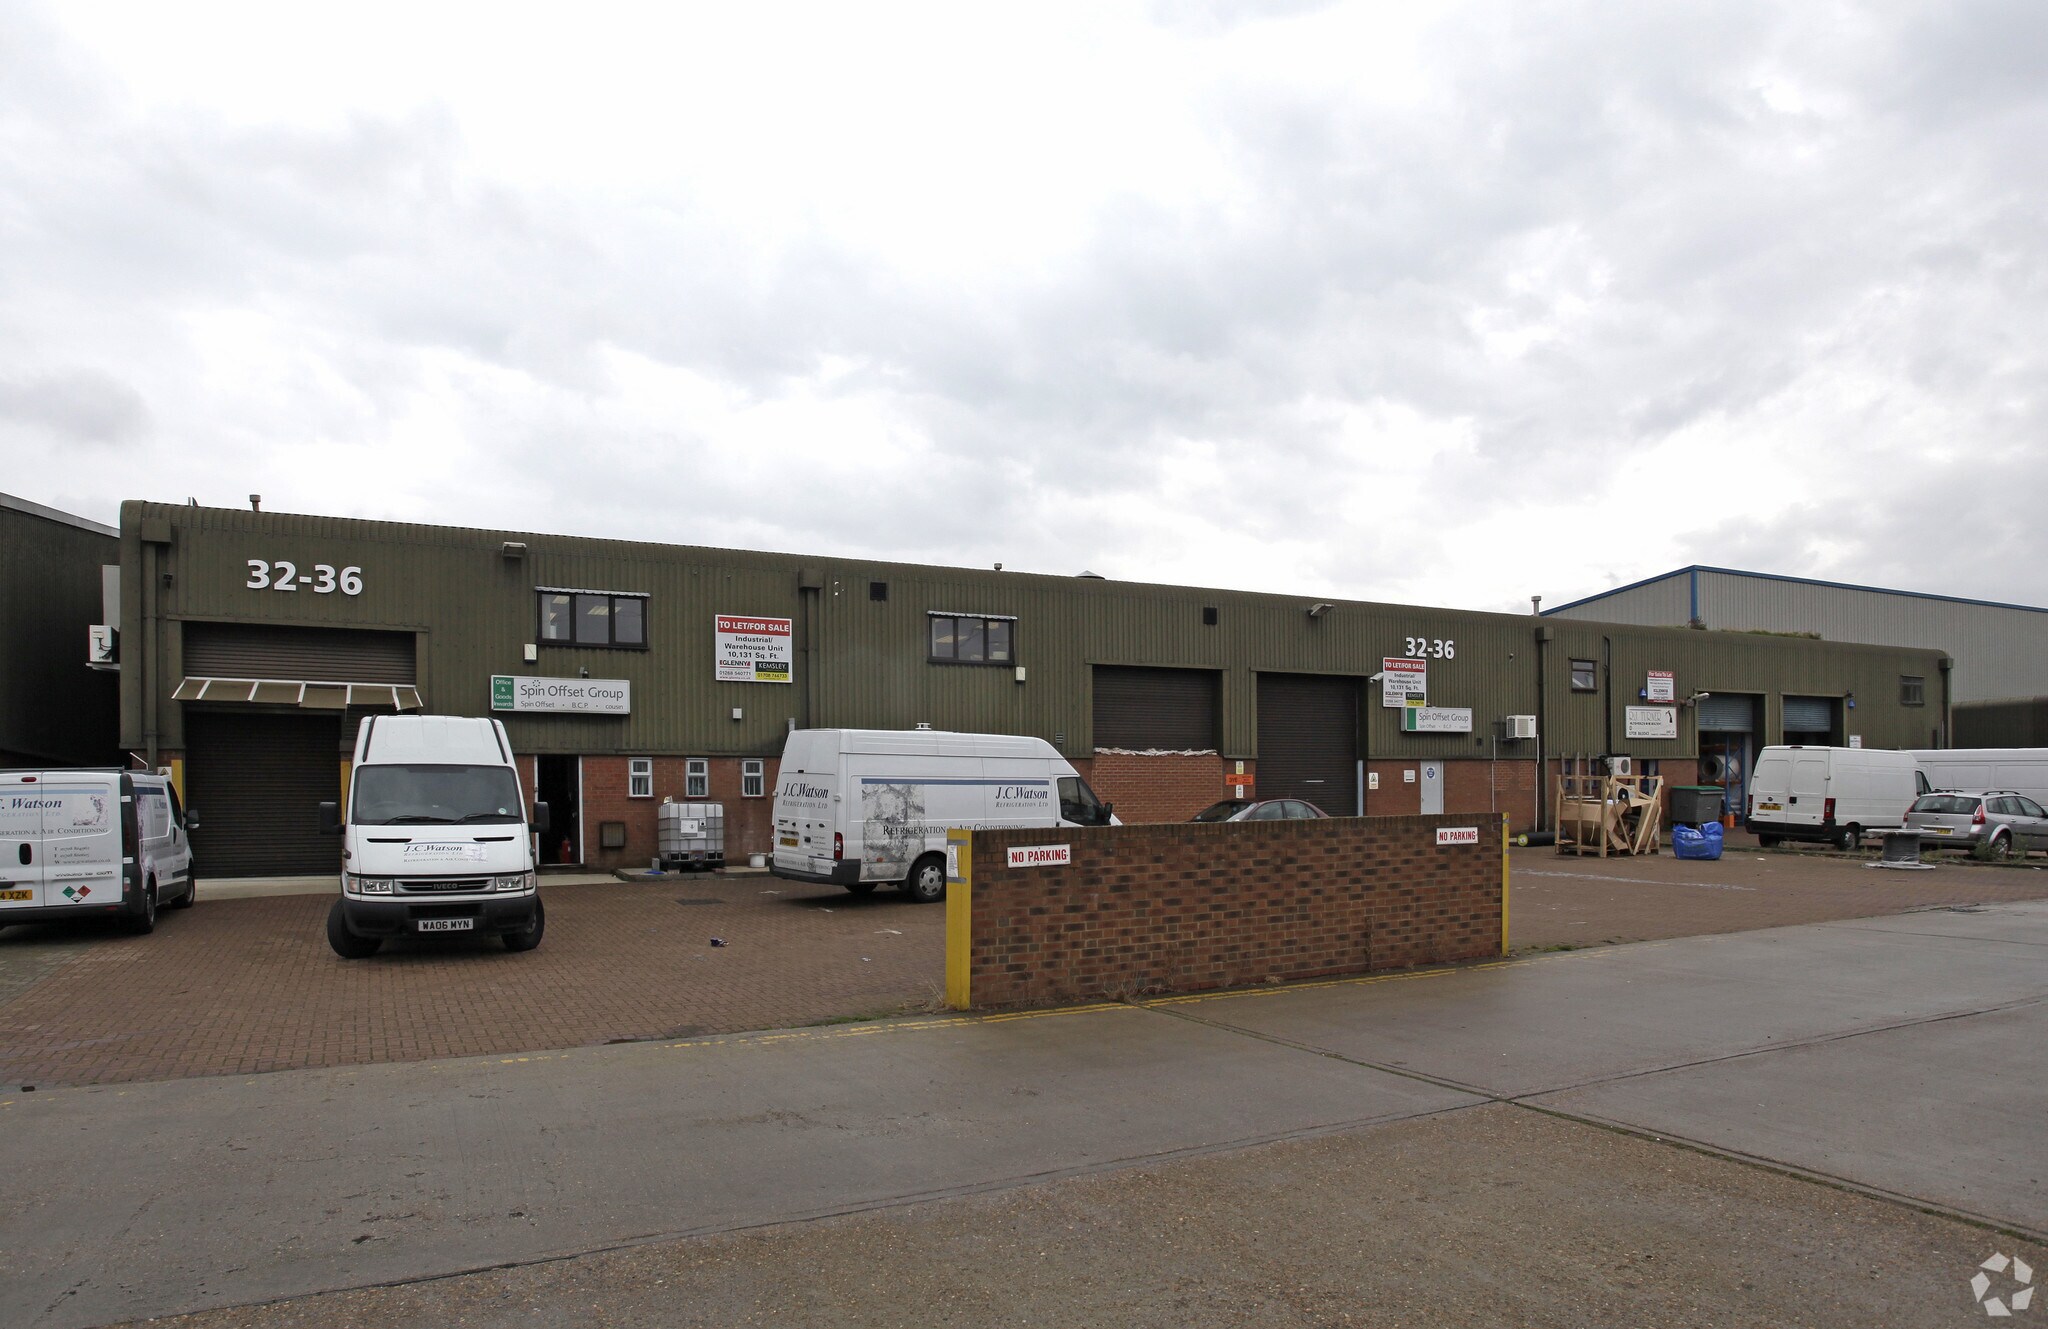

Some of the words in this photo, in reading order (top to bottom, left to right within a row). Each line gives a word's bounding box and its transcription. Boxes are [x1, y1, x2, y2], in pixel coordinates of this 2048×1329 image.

[246, 559, 363, 595] 32-36
[733, 622, 766, 630] LET/FOR
[768, 624, 789, 632] SALE
[725, 643, 766, 651] Warehouse
[1405, 637, 1455, 660] 32-36
[520, 685, 545, 699] Spin
[548, 685, 584, 697] Offset
[588, 687, 624, 701] Group
[1419, 713, 1431, 723] Spin
[1432, 713, 1449, 721] Offset
[1451, 714, 1468, 723] Group
[1439, 832, 1447, 841] NO
[1450, 831, 1476, 840] PARKING
[1011, 851, 1024, 863] NO
[1028, 849, 1067, 862] PARKING
[9, 891, 28, 899] XZK
[422, 921, 448, 930] WA06
[451, 920, 470, 930] MYN
